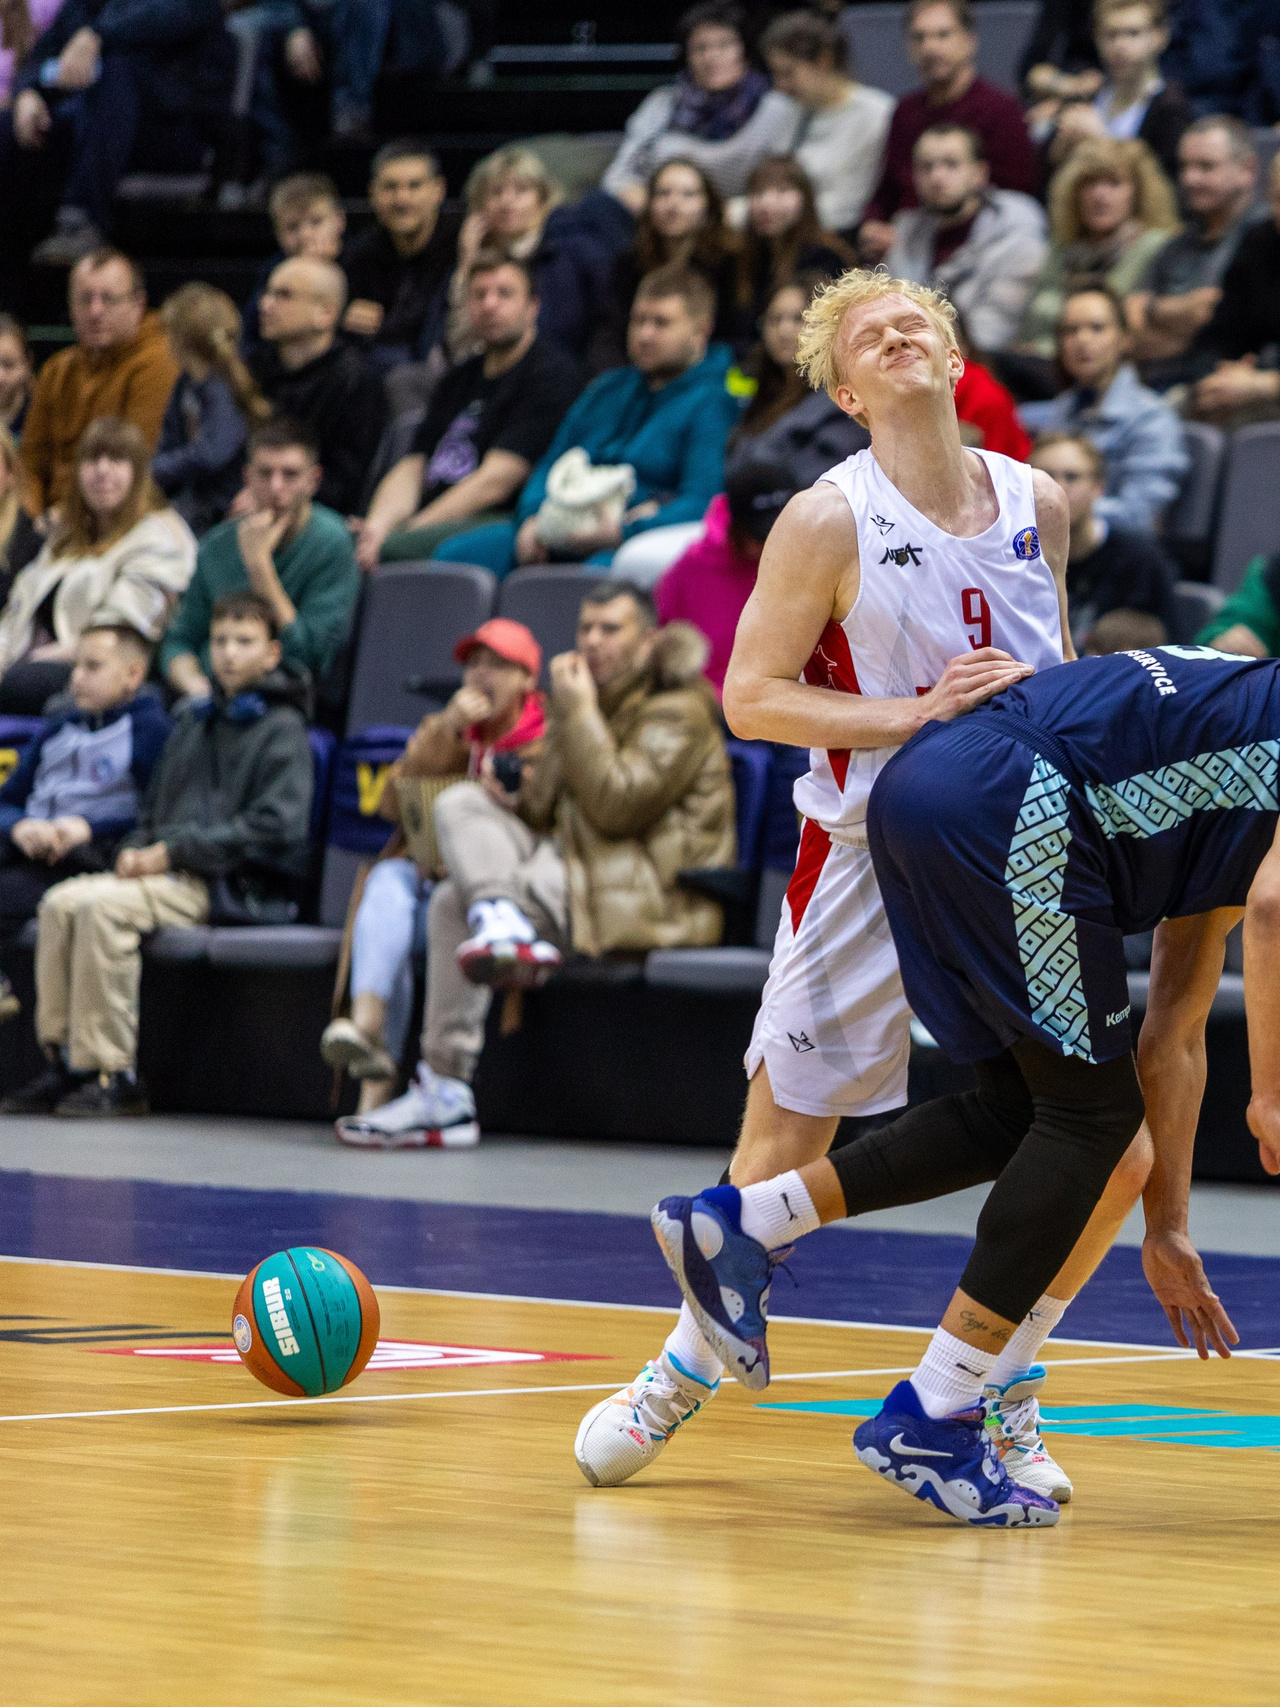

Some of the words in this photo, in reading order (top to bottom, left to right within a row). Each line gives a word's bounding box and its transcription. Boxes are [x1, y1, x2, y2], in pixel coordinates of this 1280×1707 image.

[961, 588, 992, 650] 9
[1114, 649, 1178, 696] SERVICE
[262, 1276, 301, 1357] SIBUR
